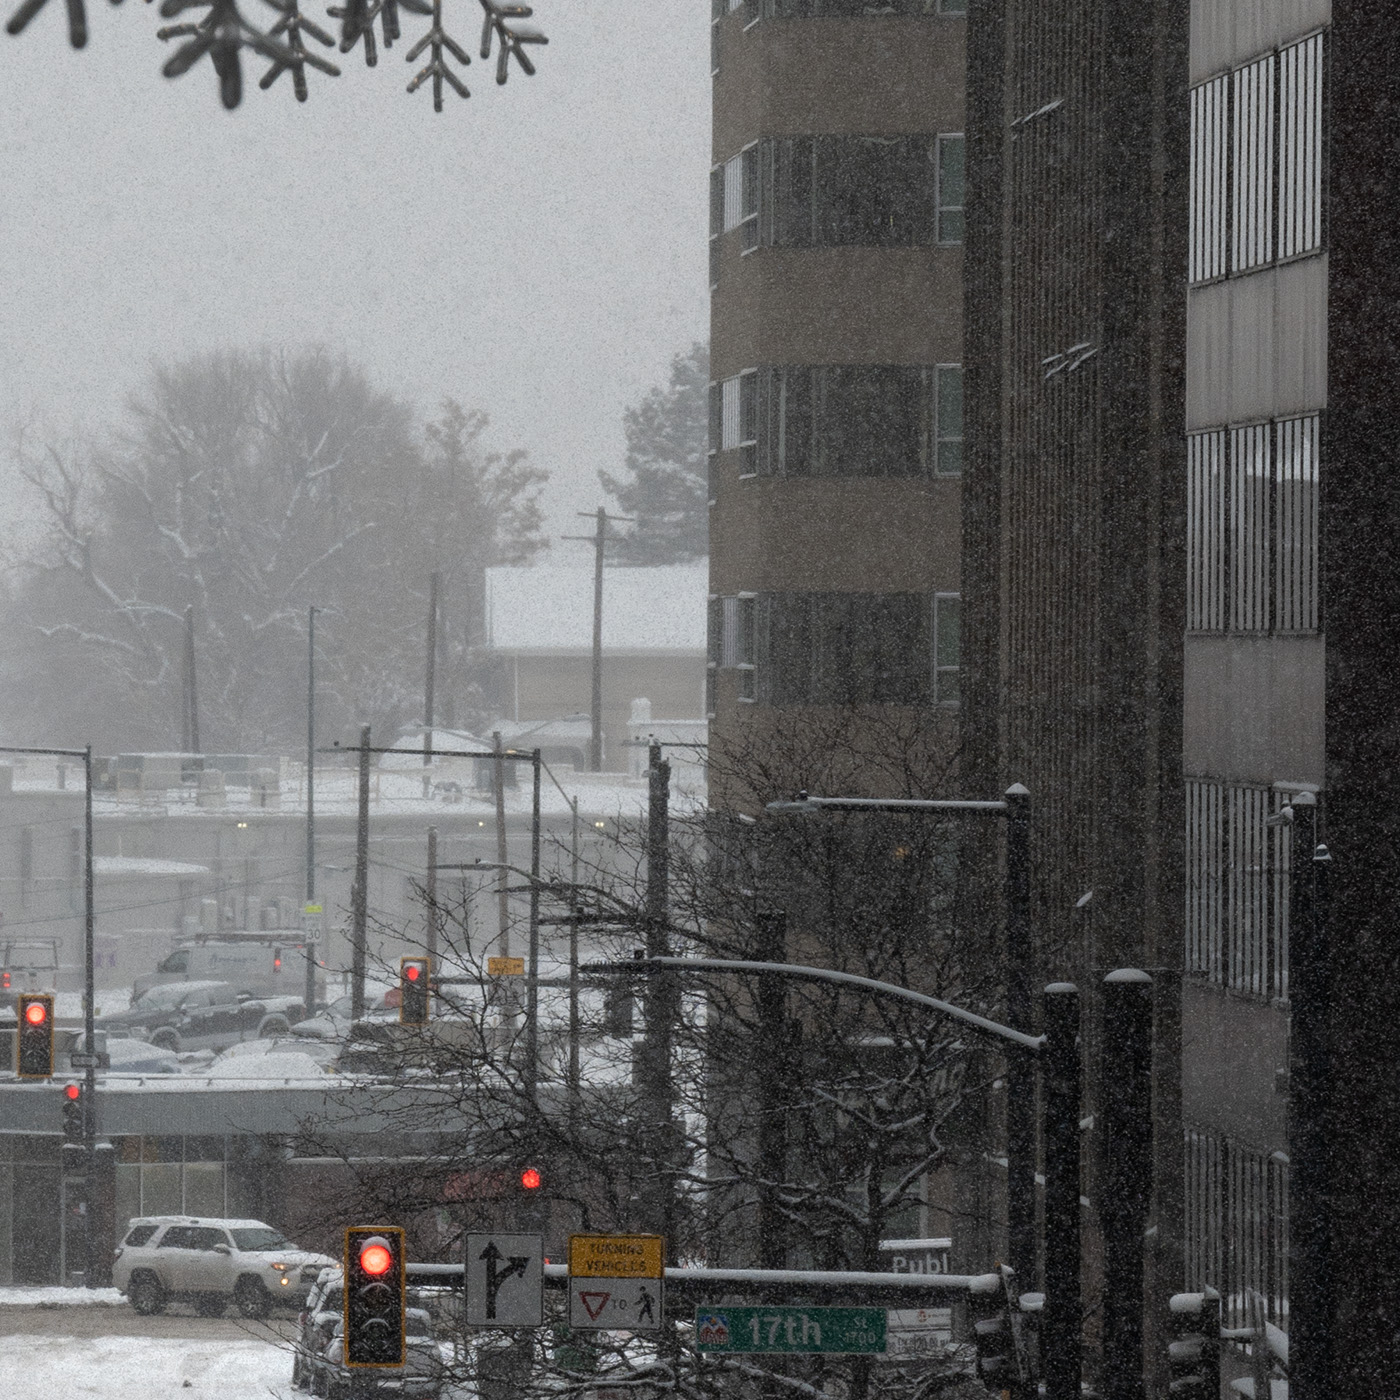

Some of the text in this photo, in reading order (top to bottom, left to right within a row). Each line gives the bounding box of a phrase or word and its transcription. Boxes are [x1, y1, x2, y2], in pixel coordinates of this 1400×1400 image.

[590, 1243, 645, 1255] TURNING
[586, 1260, 648, 1273] VEHICLES
[610, 1299, 627, 1310] TO
[748, 1314, 821, 1345] 17th
